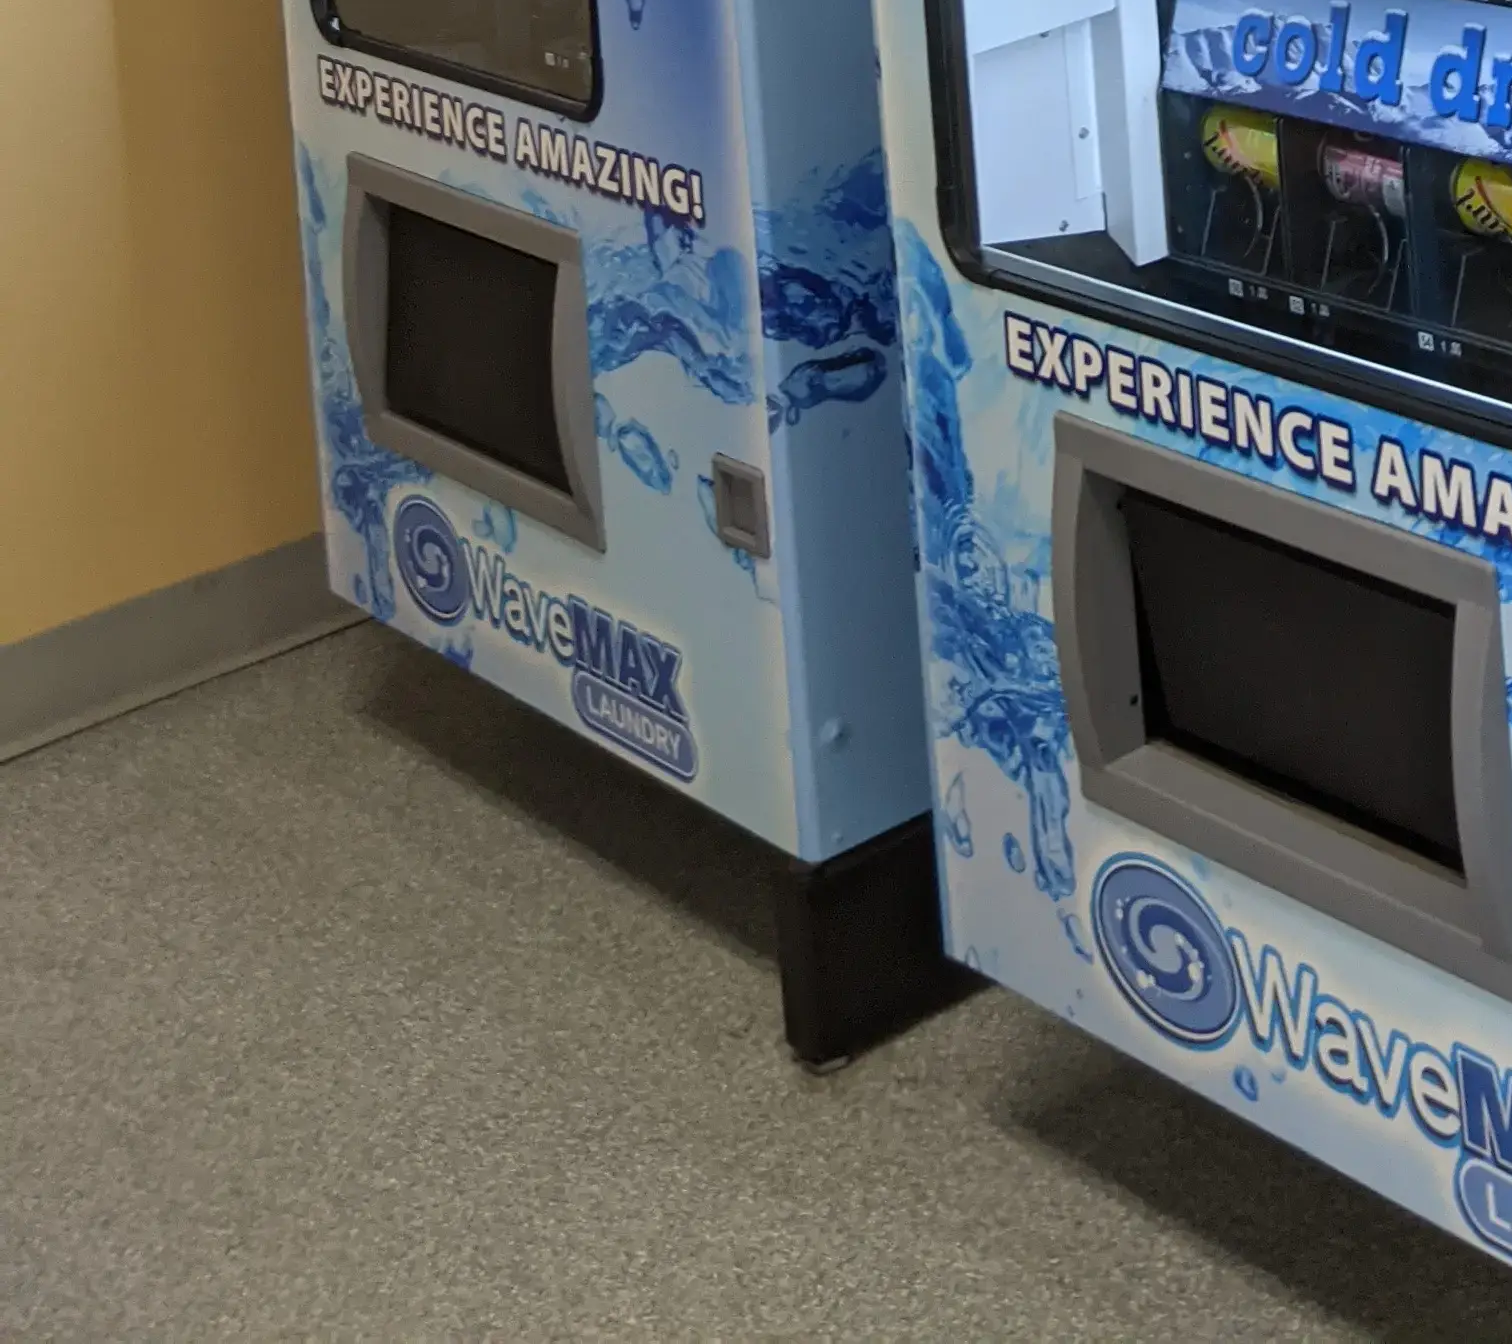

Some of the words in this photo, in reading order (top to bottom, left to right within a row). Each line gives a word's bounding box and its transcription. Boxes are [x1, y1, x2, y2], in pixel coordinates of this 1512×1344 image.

[317, 53, 507, 160] EXPERIENCE
[515, 117, 706, 226] AMAZING!
[1003, 310, 1356, 492] EXPERIENCE
[459, 537, 690, 725] WaveMAX
[585, 686, 681, 761] LAUNDRY
